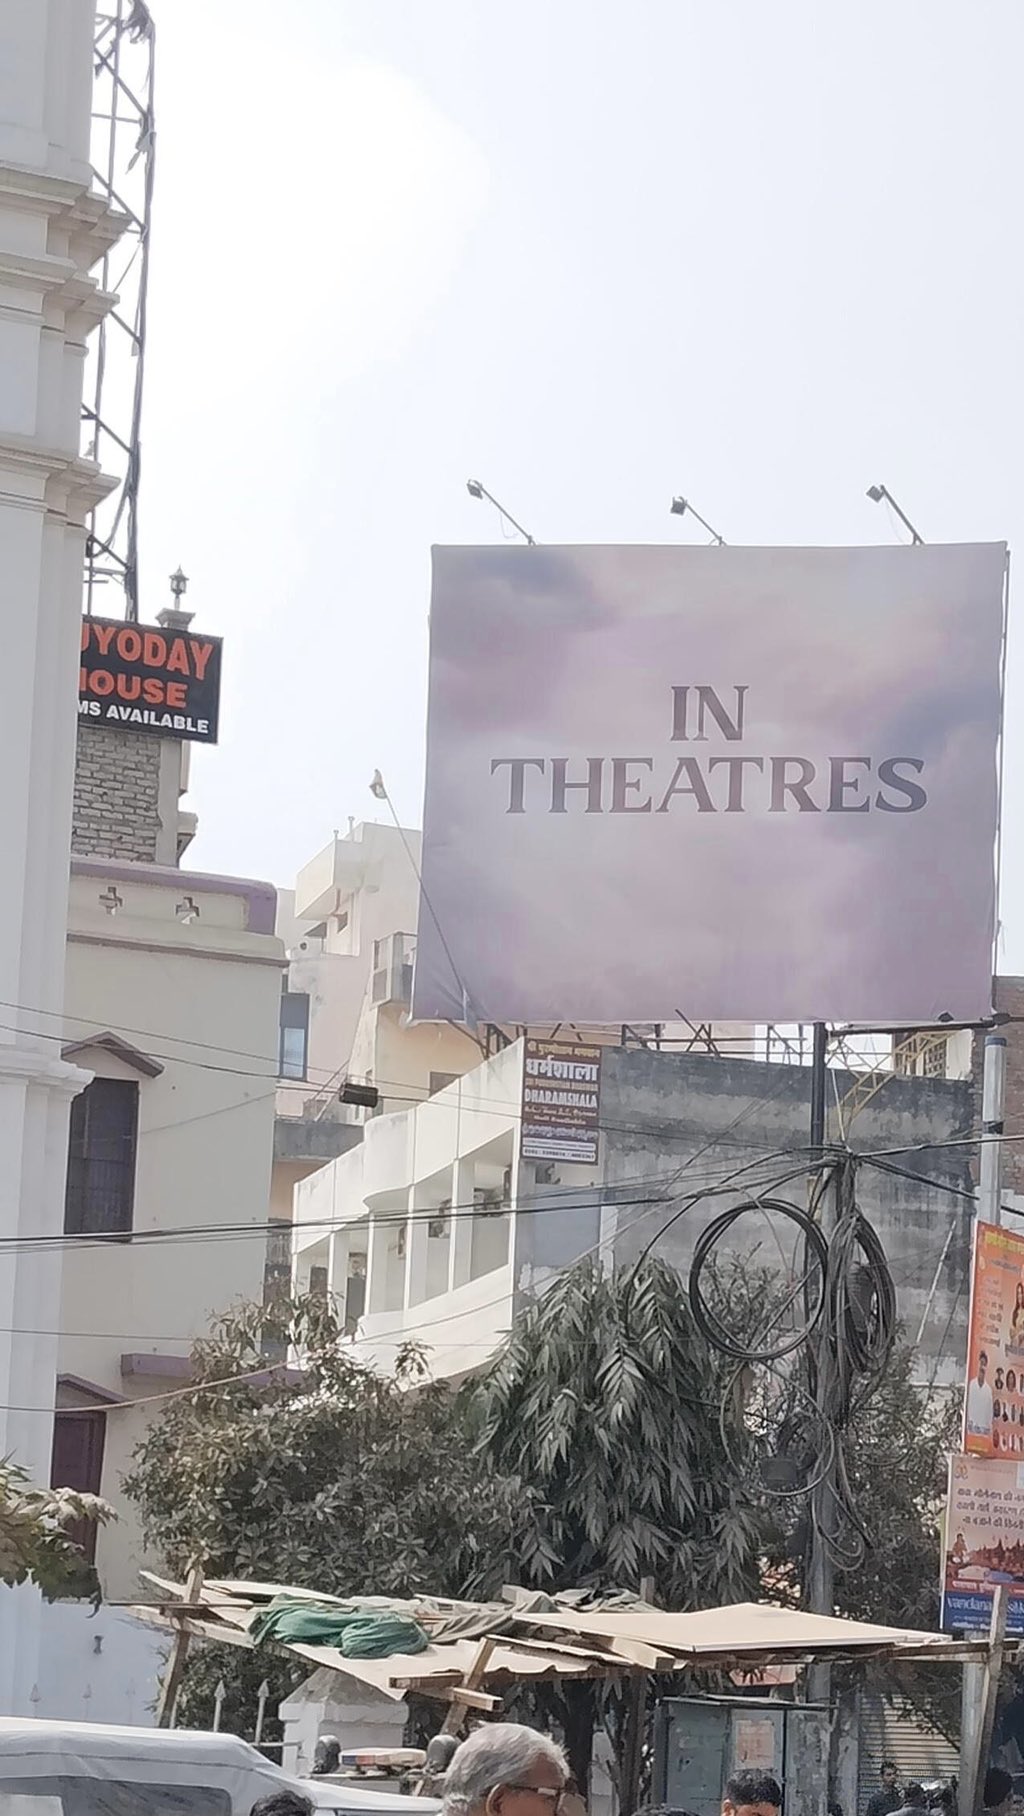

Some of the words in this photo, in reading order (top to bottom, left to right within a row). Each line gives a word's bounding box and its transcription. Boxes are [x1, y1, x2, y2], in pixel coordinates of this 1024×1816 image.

[106, 704, 209, 735] AVAILABLE
[668, 684, 749, 742] IN
[490, 756, 928, 815] THEATRES
[524, 1088, 598, 1109] DHARAMSHALA
